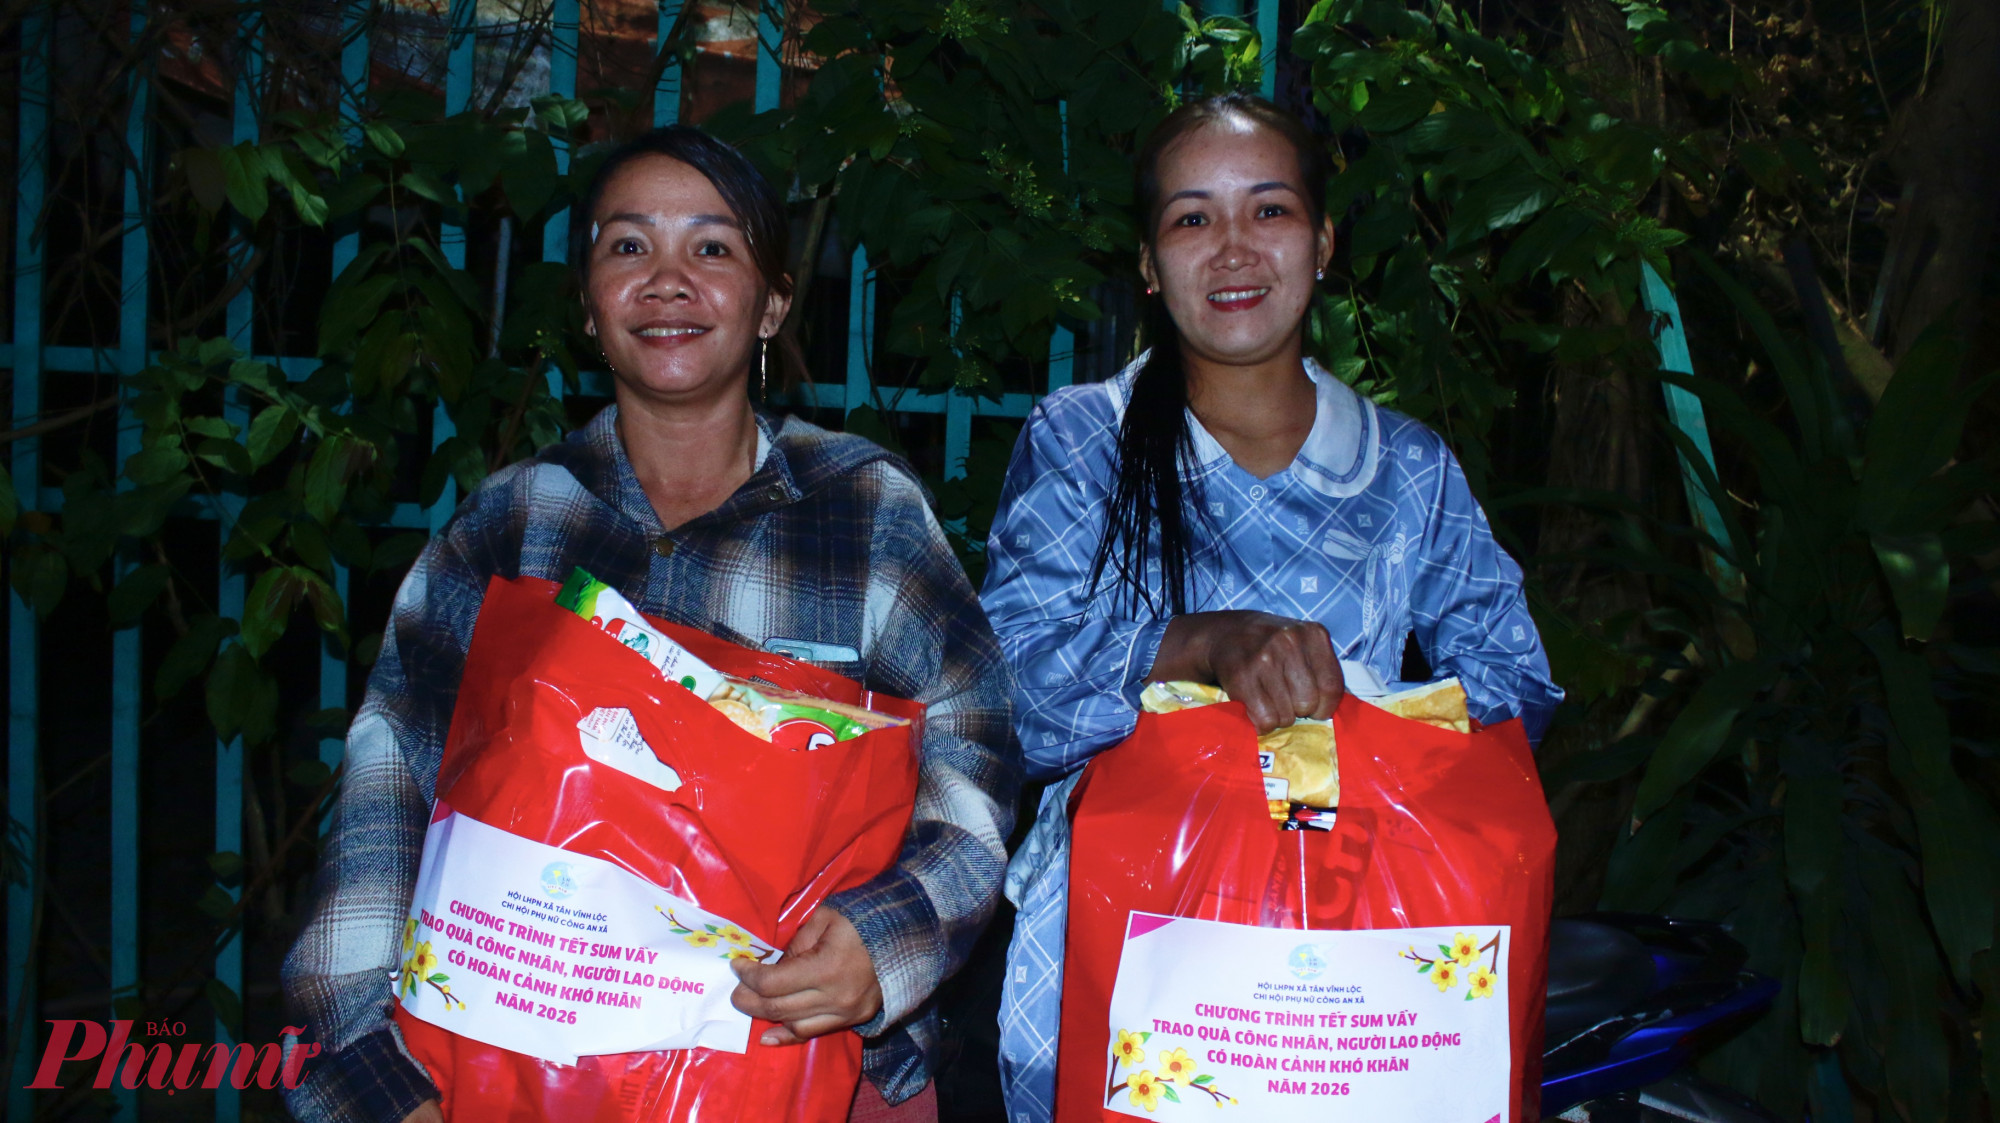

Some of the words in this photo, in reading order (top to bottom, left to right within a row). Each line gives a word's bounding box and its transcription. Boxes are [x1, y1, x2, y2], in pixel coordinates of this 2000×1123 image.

[450, 900, 504, 932] CHƯƠNG
[509, 922, 554, 948] TRÌNH
[559, 937, 589, 955] TẾT
[590, 944, 622, 960] SUM
[420, 908, 444, 932] TRAO
[446, 924, 472, 945] QUÀ
[476, 936, 516, 960] CÔNG
[518, 950, 567, 976] NHÂN,
[572, 965, 620, 982] NGƯỜI
[624, 972, 654, 986] LAO
[659, 977, 704, 994] ĐỘNG
[448, 950, 465, 966] CÓ
[467, 957, 511, 983] HOÀN
[514, 974, 557, 996] CẢNH
[560, 986, 594, 1002] KHÓ
[596, 991, 642, 1009] KHĂN
[496, 992, 534, 1013] NĂM
[537, 1004, 576, 1024] 2026
[1196, 1004, 1260, 1023] CHƯƠNG
[1266, 1012, 1314, 1026] TRÌNH
[1319, 1011, 1347, 1027] TẾT
[1352, 1014, 1383, 1028] SUM
[1153, 1019, 1194, 1036] TRAO
[1198, 1026, 1230, 1042] QUÀ
[1236, 1030, 1277, 1047] CÔNG
[1282, 1035, 1332, 1051] NHÂN,
[1338, 1034, 1386, 1050] NGƯỜI
[1390, 1035, 1418, 1049] LAO
[1422, 1032, 1460, 1050] ĐỘNG
[1208, 1049, 1227, 1064] CÓ
[1231, 1053, 1277, 1070] HOÀN
[1282, 1056, 1325, 1072] CẢNH
[1330, 1058, 1363, 1072] KHÓ
[1368, 1056, 1408, 1072] KHĂN
[1268, 1079, 1306, 1094] NĂM
[1312, 1082, 1350, 1095] 2026
